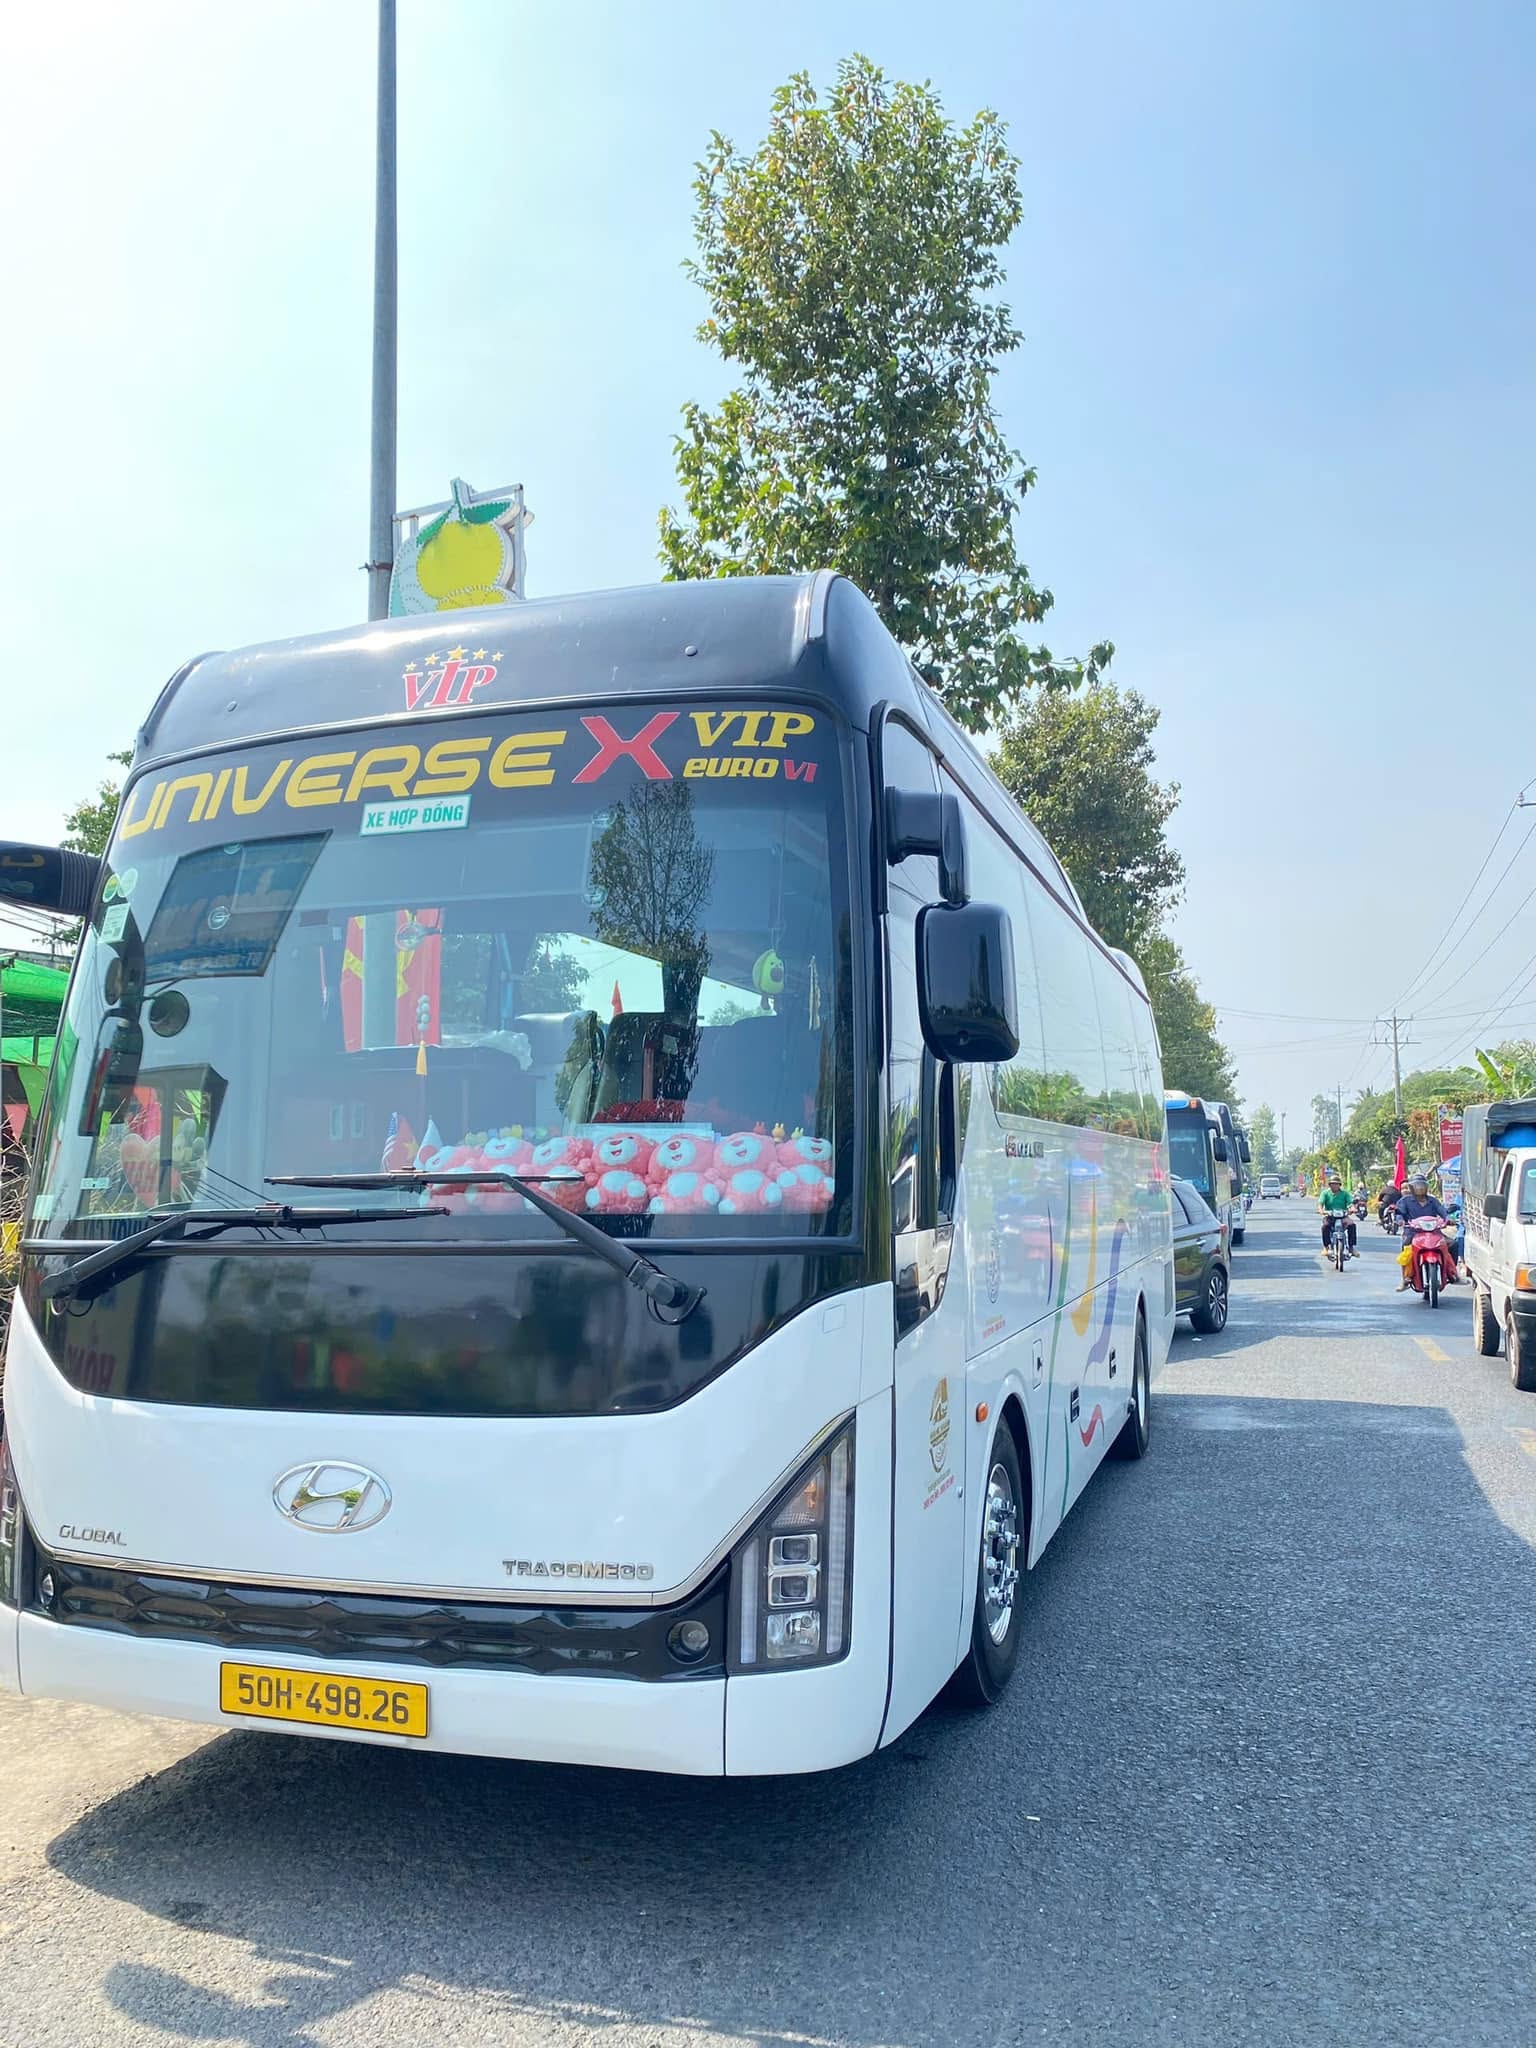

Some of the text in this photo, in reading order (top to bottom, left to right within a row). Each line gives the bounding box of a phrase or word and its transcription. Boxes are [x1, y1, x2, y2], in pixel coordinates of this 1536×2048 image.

[402, 658, 497, 711] VIP
[119, 711, 815, 841] UNIVERSE X VIP
[784, 759, 817, 783] VI
[366, 812, 384, 828] XE
[388, 807, 418, 829] HỢP
[59, 1524, 128, 1546] GLOBAL
[502, 1559, 654, 1580] TRACOMECO
[238, 1673, 409, 1725] 50H-498.26
